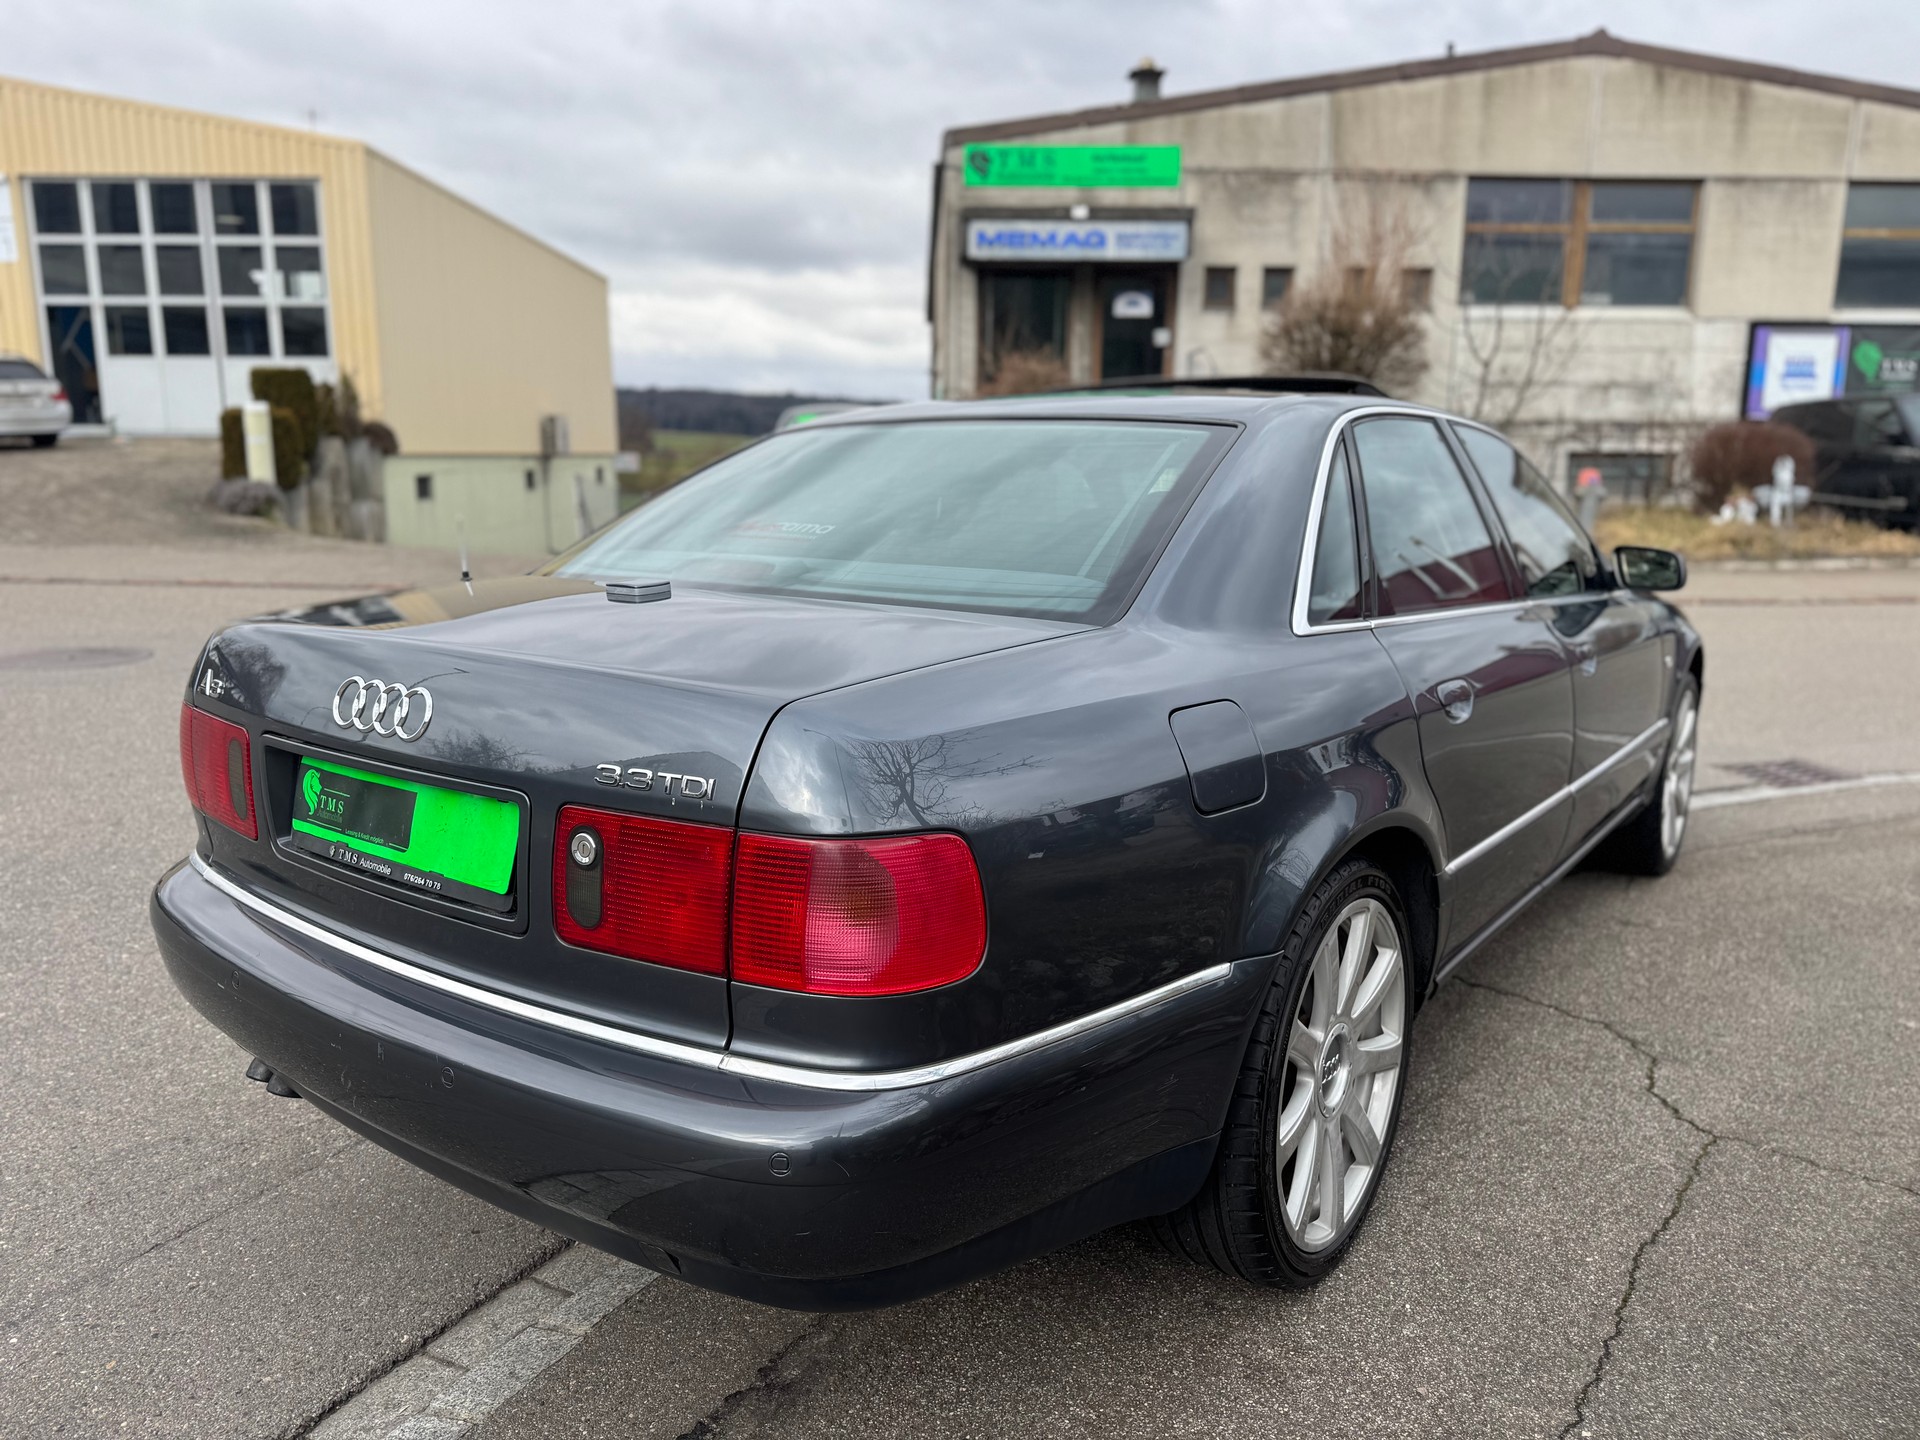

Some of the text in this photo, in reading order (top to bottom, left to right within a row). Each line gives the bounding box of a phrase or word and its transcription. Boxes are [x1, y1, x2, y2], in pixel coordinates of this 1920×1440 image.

[197, 669, 225, 698] A8
[320, 795, 344, 814] TMS
[338, 848, 358, 864] TMS
[359, 857, 392, 875] Automobile
[425, 879, 433, 887] 70
